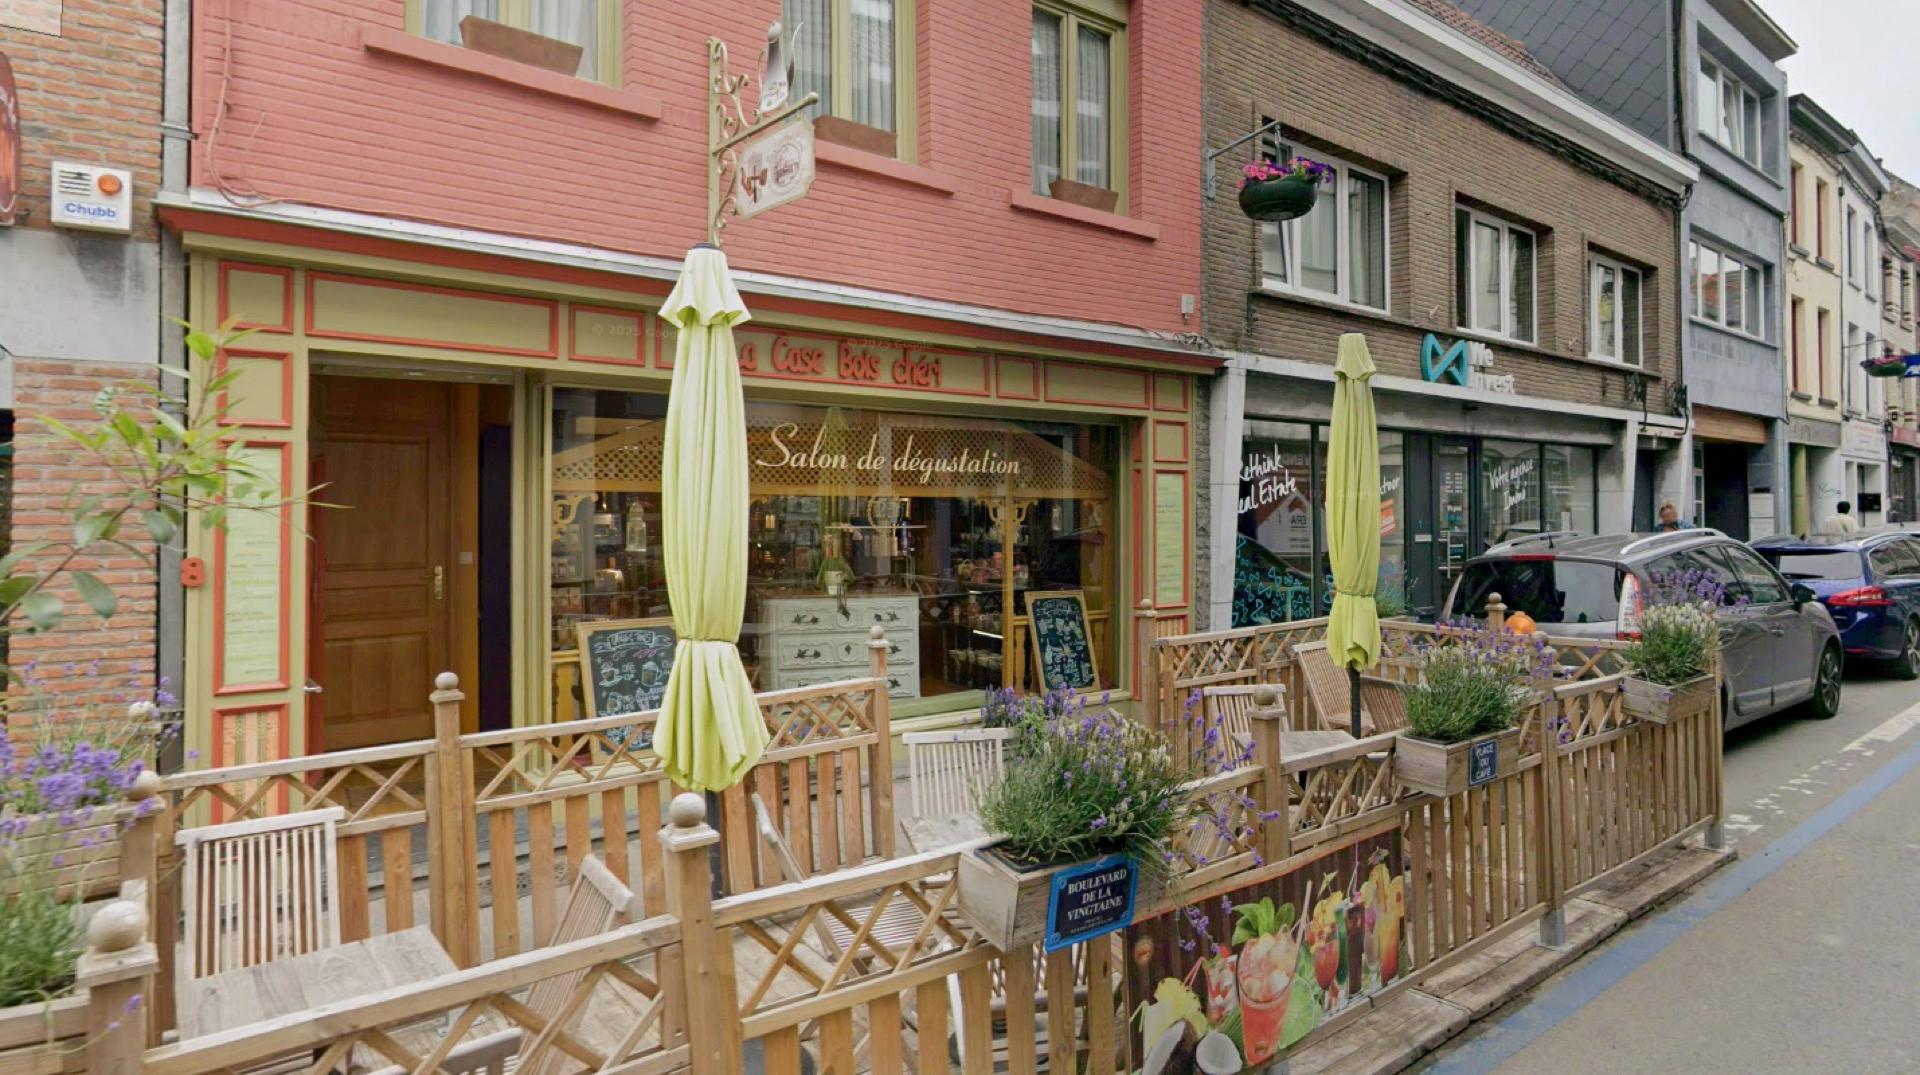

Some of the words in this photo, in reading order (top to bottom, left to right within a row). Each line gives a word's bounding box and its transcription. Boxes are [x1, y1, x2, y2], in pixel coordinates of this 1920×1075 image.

[65, 202, 116, 217] Chubb
[740, 342, 757, 370] a
[772, 335, 825, 374] Case
[839, 341, 880, 380] Bois
[756, 422, 848, 469] Salon
[856, 433, 885, 470] de
[894, 434, 1020, 483] dégustation
[1237, 484, 1259, 514] eal
[181, 557, 204, 587] 8
[1068, 869, 1127, 894] BOULEVARD
[1082, 892, 1096, 904] DE
[1098, 886, 1111, 899] LA
[1068, 896, 1123, 920] VINGTAINE
